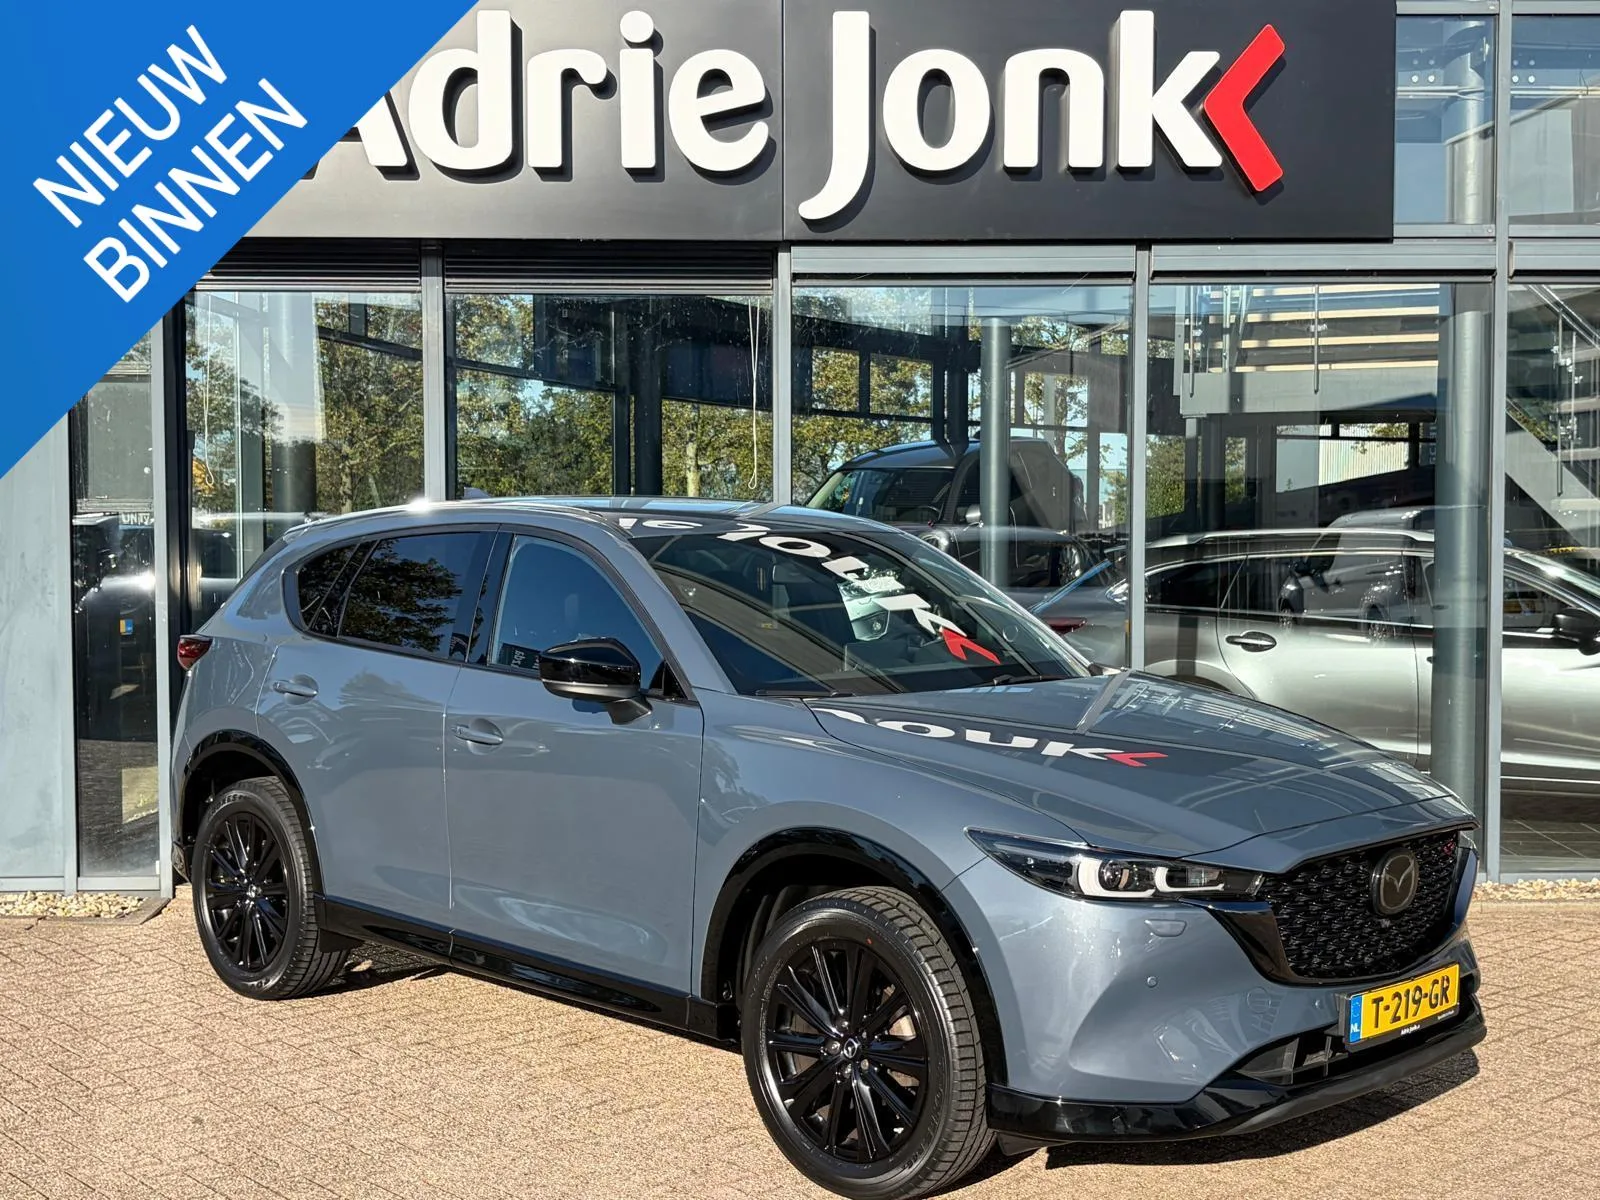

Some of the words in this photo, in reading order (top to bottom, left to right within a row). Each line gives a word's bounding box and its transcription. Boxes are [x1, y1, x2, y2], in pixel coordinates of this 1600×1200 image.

[353, 10, 769, 172] drie
[798, 10, 1223, 221] Jonk
[1350, 1023, 1361, 1034] NL
[1371, 975, 1450, 1029] T-219-GR
